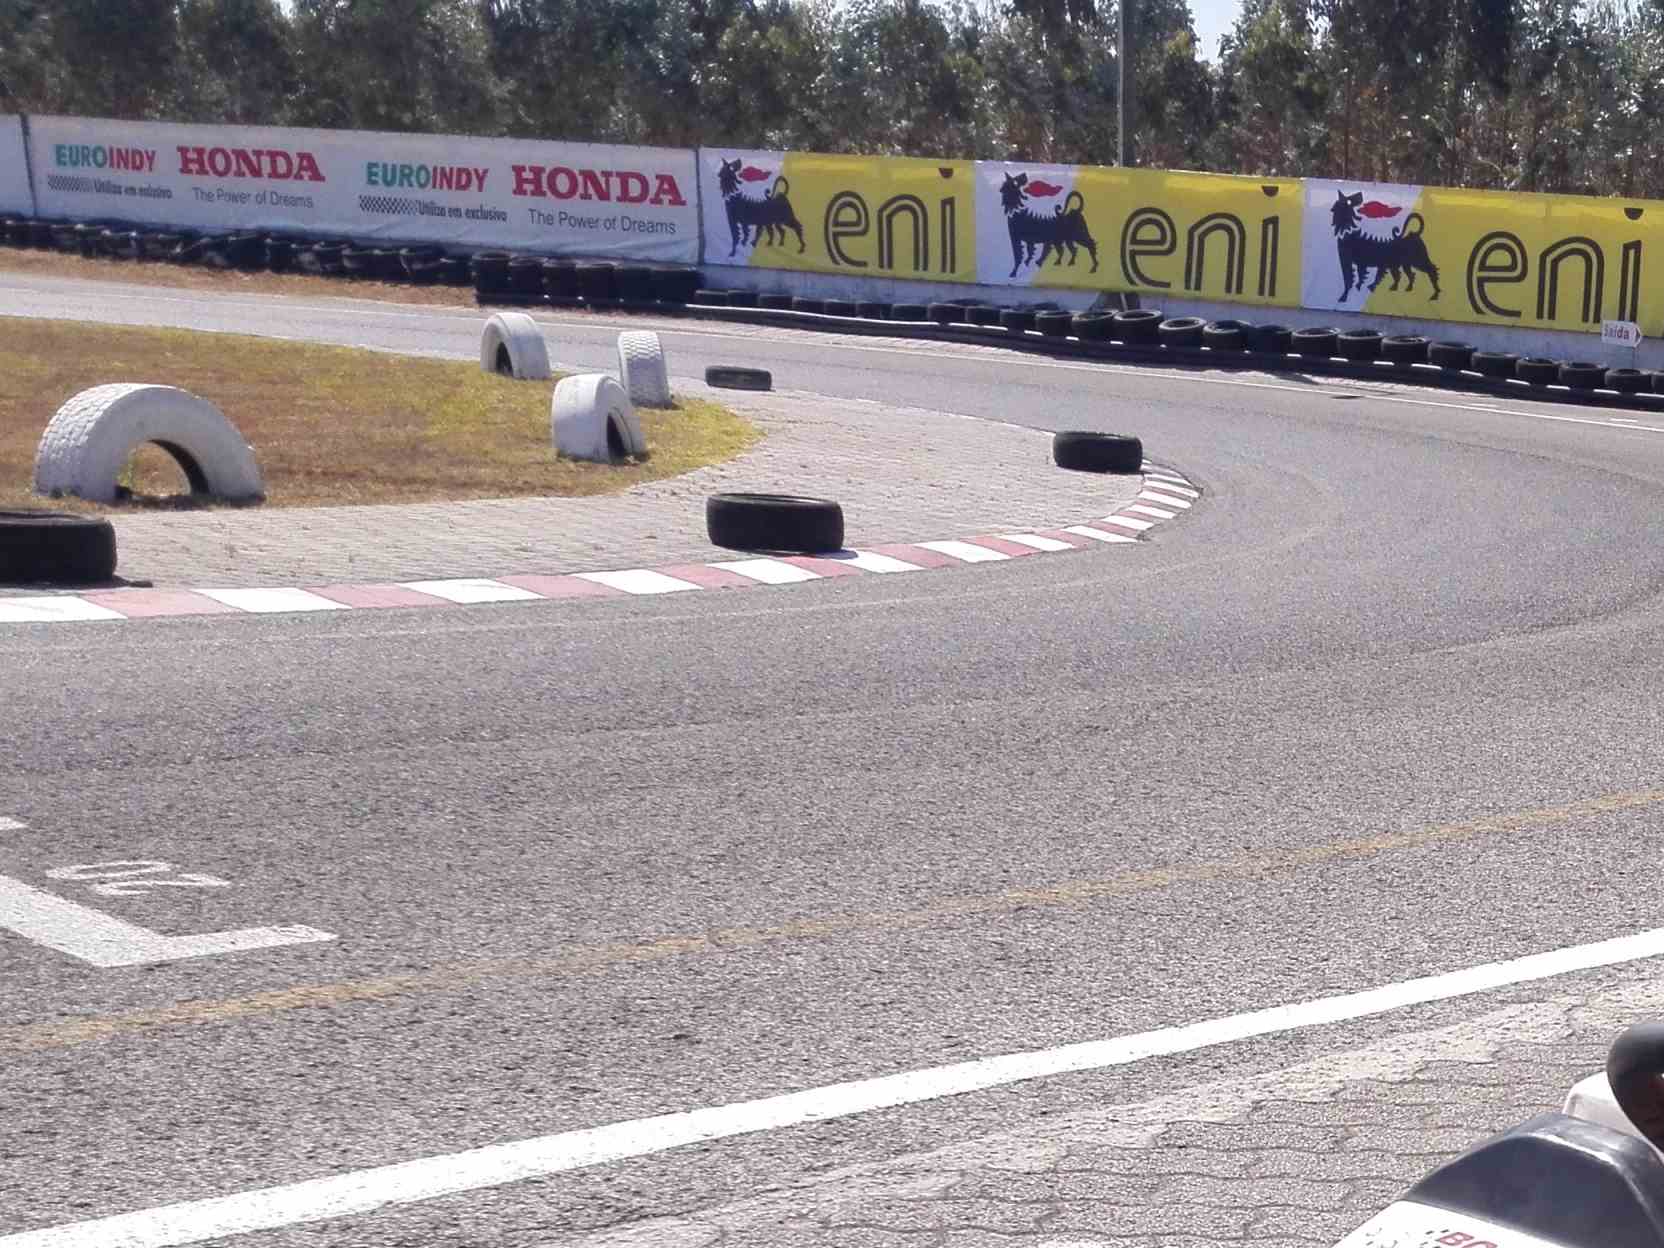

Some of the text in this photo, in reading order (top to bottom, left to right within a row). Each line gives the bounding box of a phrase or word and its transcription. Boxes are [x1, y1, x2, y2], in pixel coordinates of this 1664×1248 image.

[55, 144, 156, 172] EUROINDY
[176, 146, 326, 183] HONDA
[365, 162, 489, 193] EUROINDY
[511, 164, 687, 207] HONDA
[192, 187, 314, 208] The Power of Dreams
[465, 204, 508, 222] exclusivo
[528, 208, 677, 235] The Power of Dreams
[823, 167, 958, 275] eni
[1120, 185, 1280, 296] eni
[1466, 207, 1644, 324] eni
